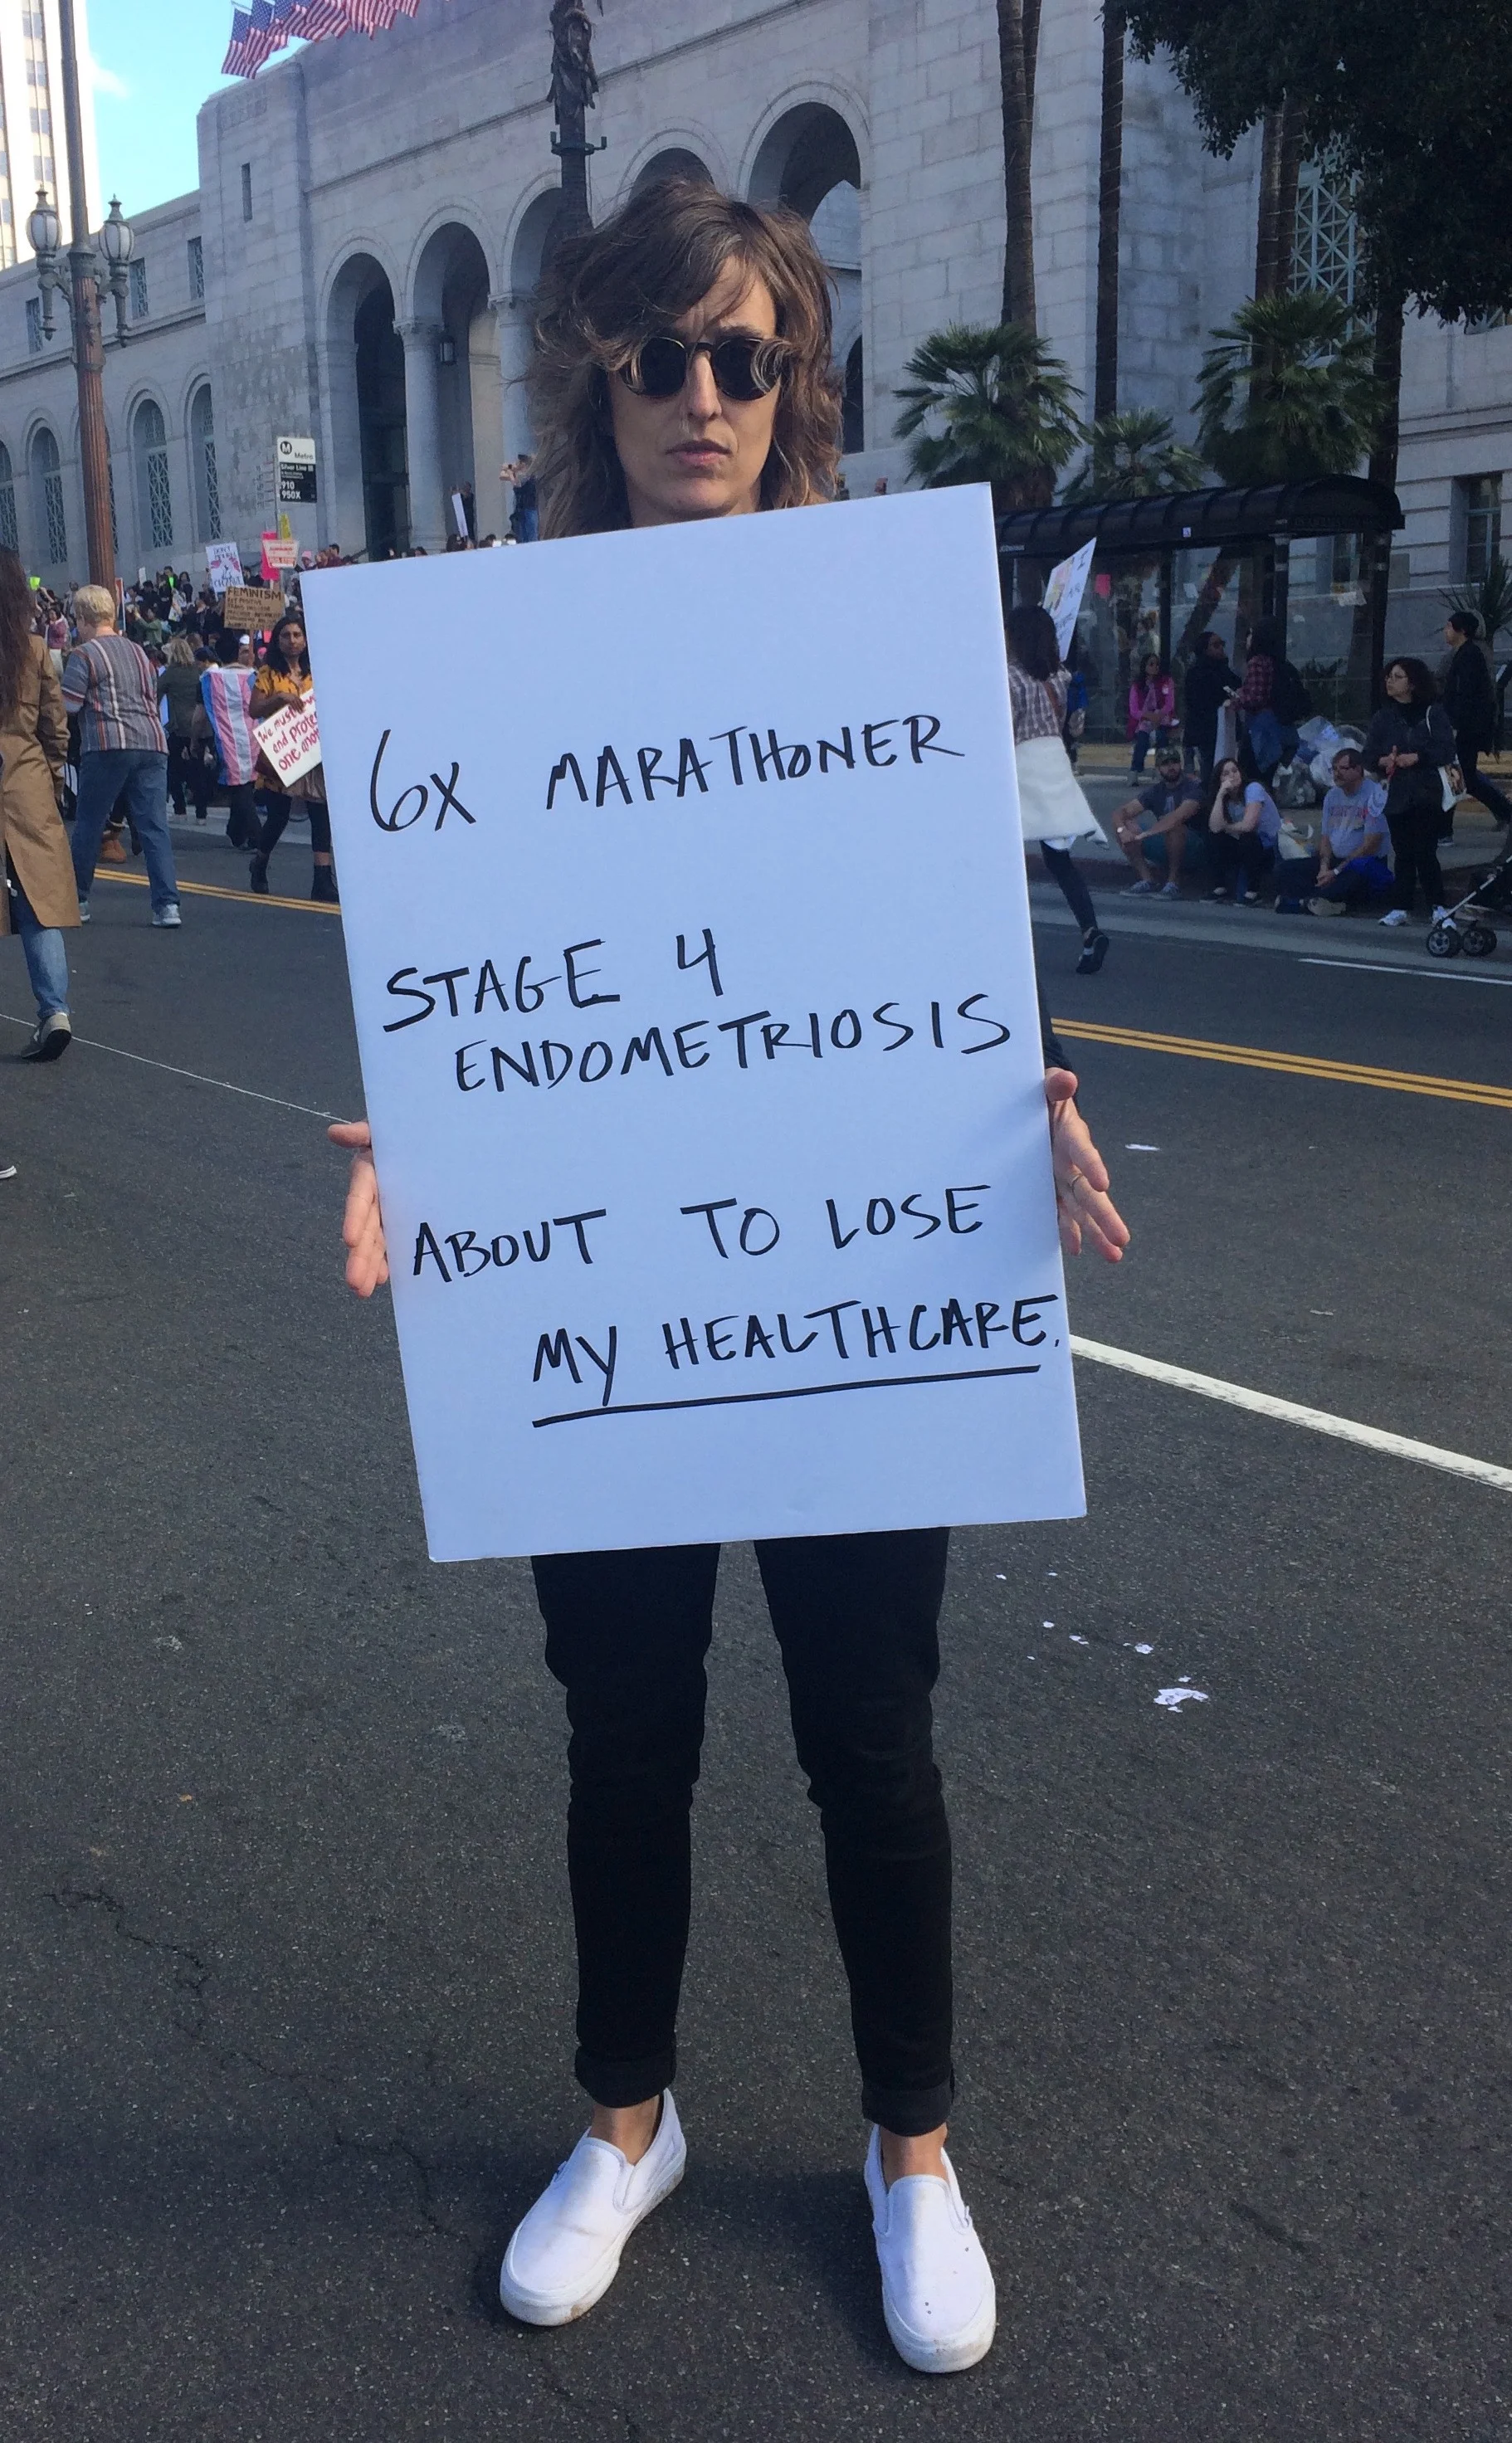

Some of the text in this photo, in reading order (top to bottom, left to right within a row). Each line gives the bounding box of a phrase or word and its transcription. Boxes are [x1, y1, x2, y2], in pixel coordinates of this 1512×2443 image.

[281, 480, 295, 490] 910
[281, 490, 301, 500] 950X
[227, 586, 281, 601] FEMINISM
[258, 705, 297, 744] We must
[272, 730, 289, 753] and
[278, 749, 301, 771] one
[546, 714, 965, 810] MARATHONER
[383, 929, 724, 1032] STAGE 4
[454, 994, 1011, 1093] ENDOMETRIOSIS
[412, 1185, 991, 1282] ABOUT TO LOSE
[532, 1295, 1061, 1407] MY HEALTHCARE.
